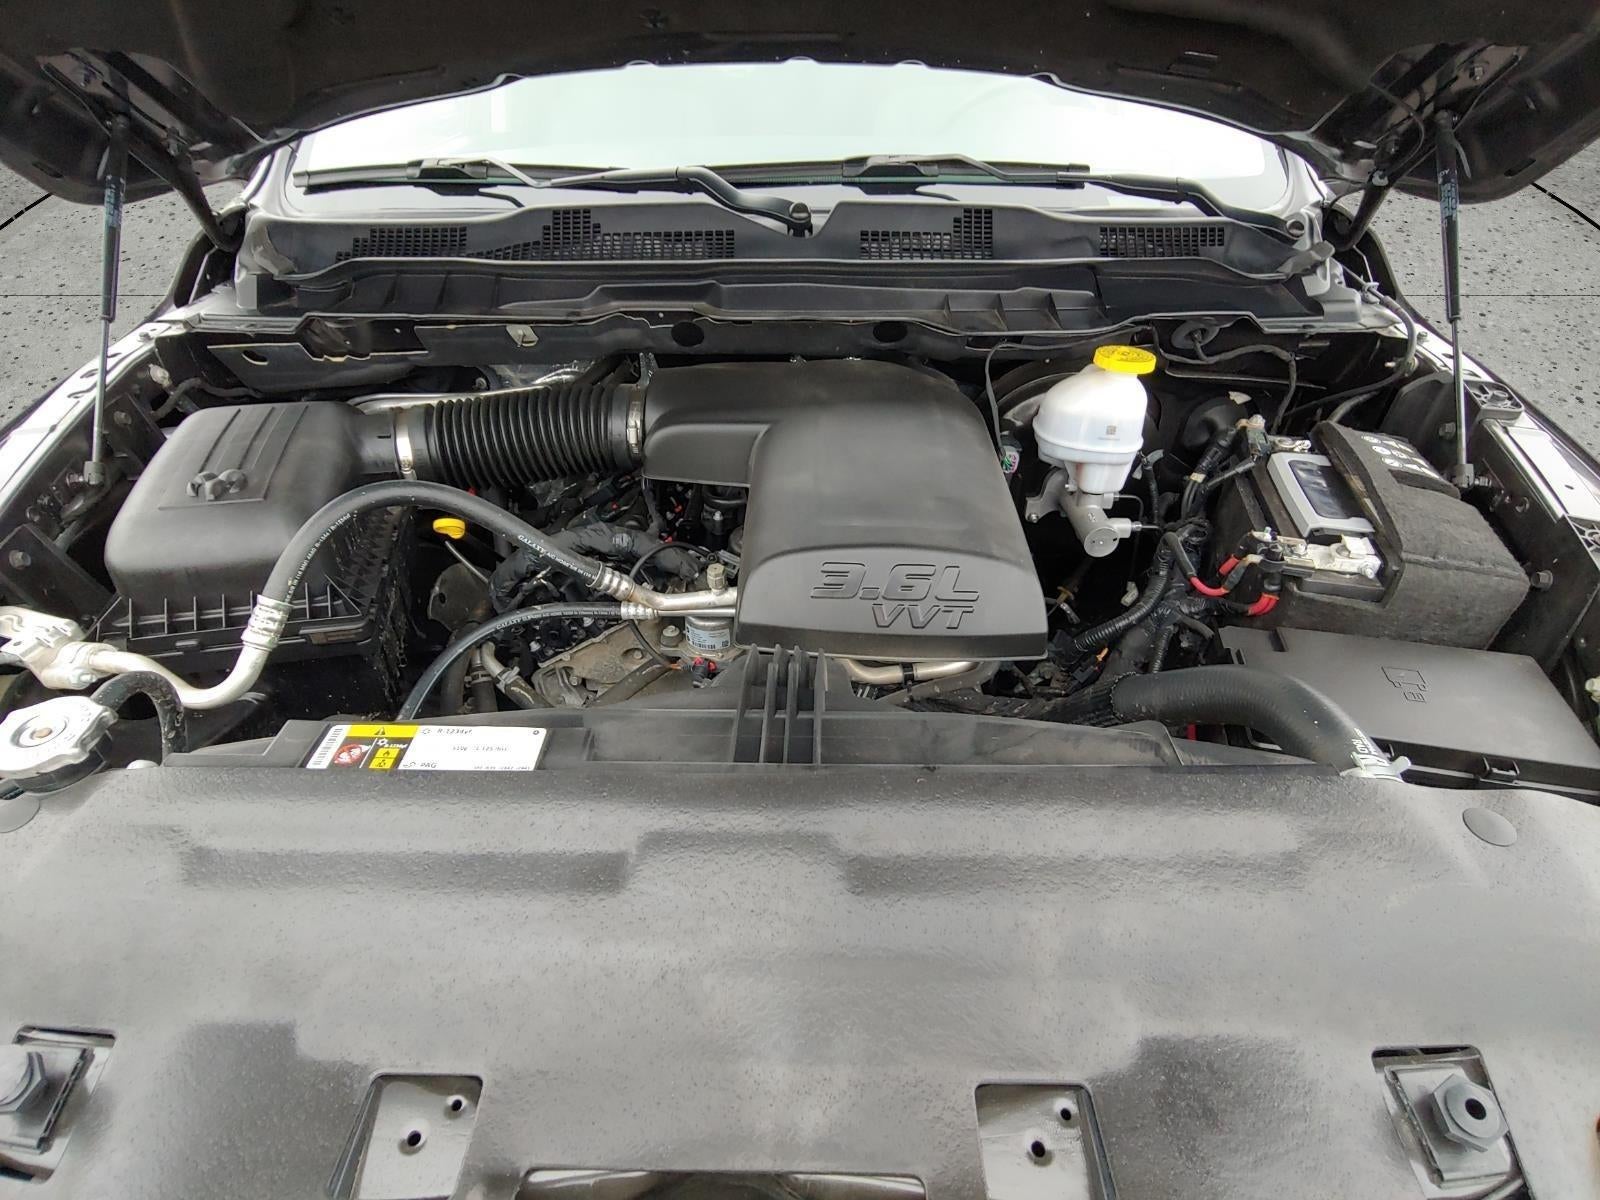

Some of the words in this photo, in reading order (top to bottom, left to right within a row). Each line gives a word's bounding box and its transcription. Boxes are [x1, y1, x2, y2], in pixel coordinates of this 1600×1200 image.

[517, 534, 546, 554] GALAXY
[810, 561, 979, 601] 3.6L
[871, 603, 974, 629] VVT
